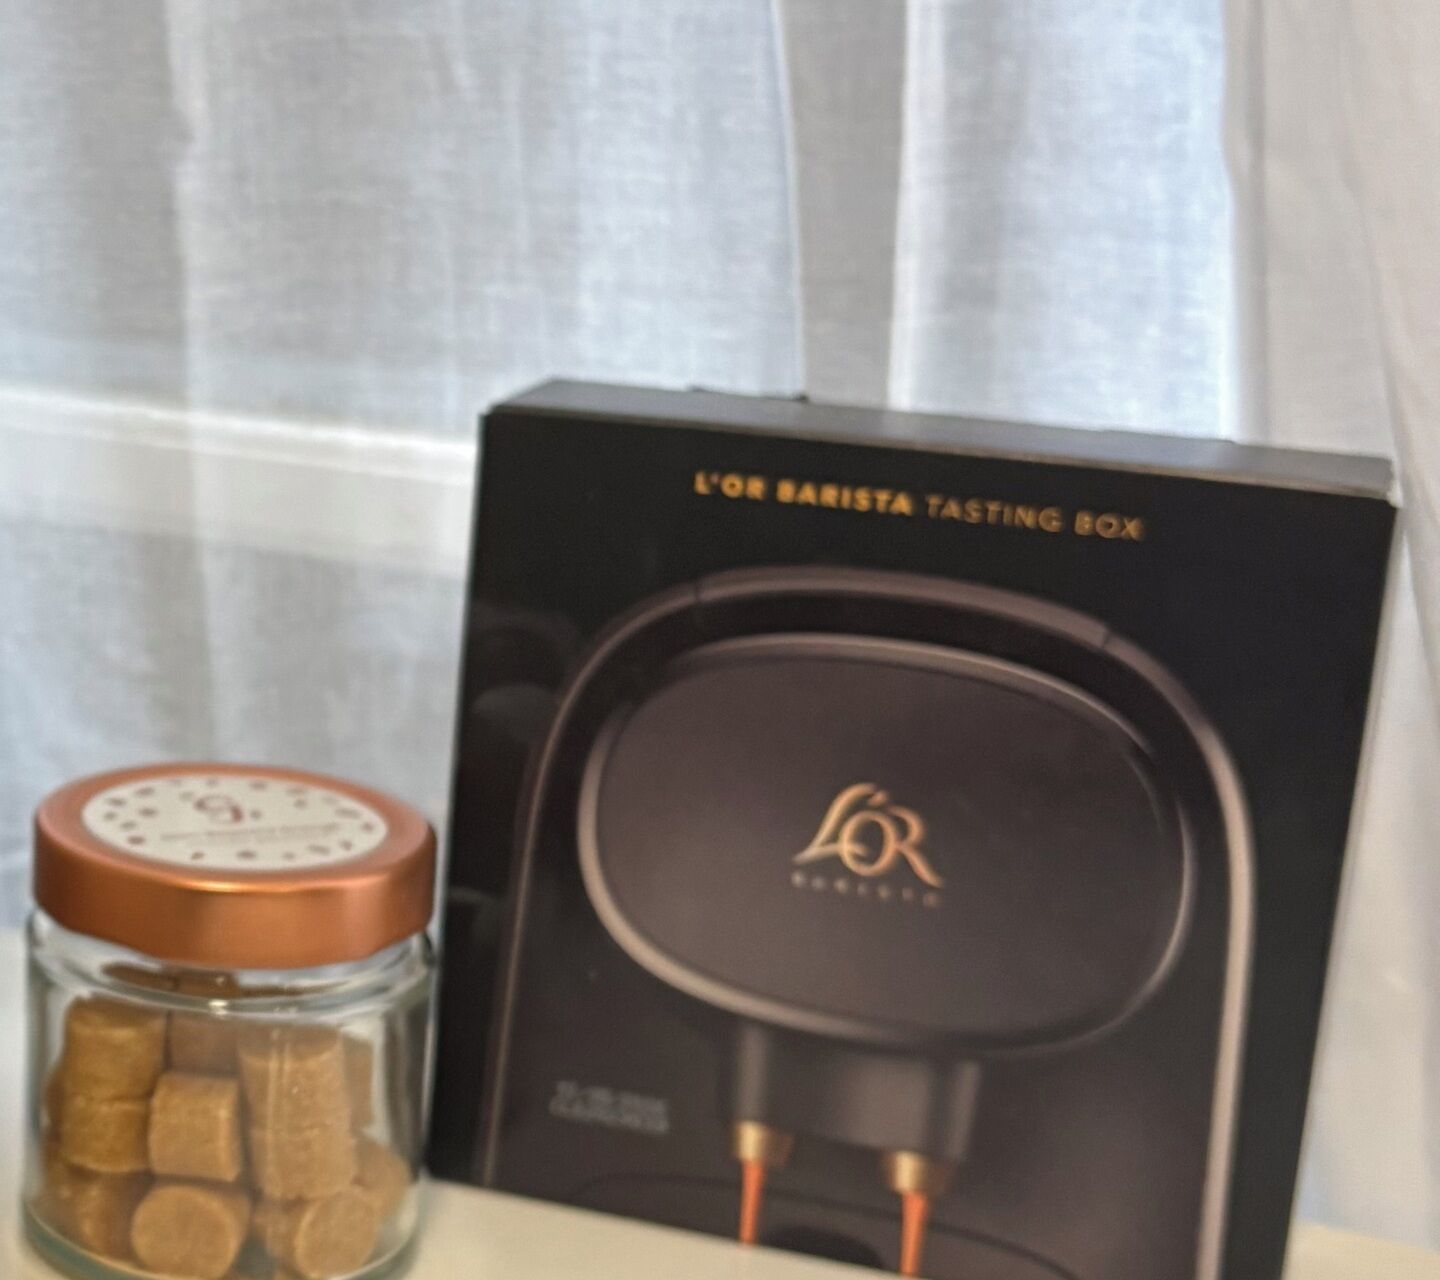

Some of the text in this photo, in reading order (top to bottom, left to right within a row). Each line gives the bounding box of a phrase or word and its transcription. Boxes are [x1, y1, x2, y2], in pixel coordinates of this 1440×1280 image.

[693, 470, 1146, 542] L'OR BARISTA TASTING BOX
[792, 781, 943, 889] L'OR
